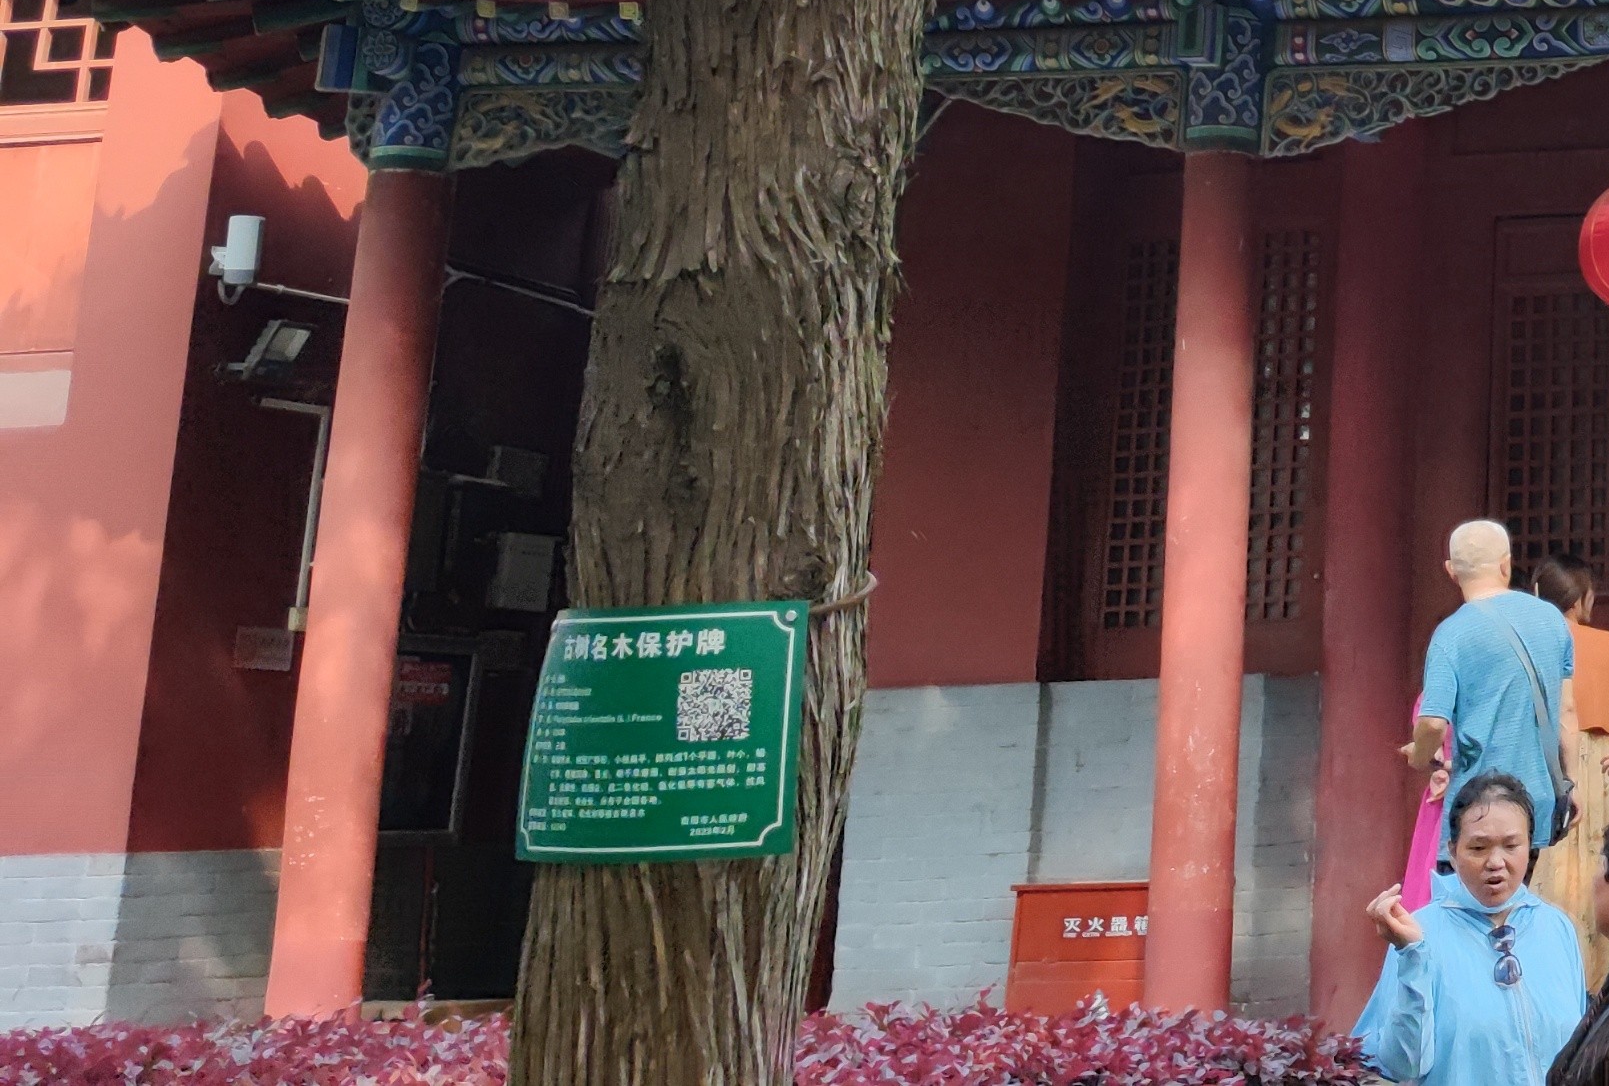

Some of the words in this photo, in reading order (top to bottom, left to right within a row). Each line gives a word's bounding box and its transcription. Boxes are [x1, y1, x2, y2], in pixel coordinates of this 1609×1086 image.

[564, 629, 725, 660] 古树名木保护牌
